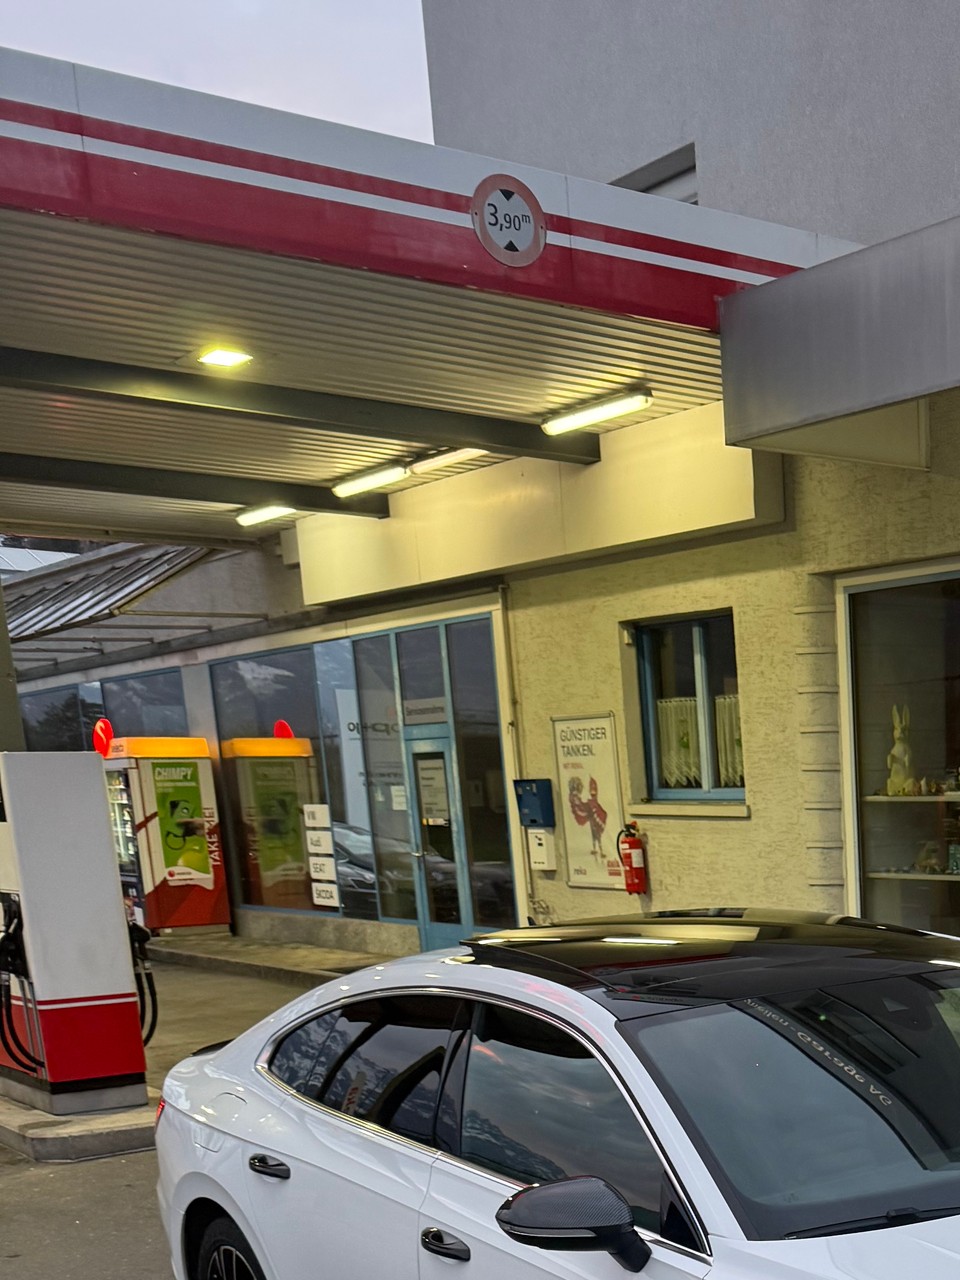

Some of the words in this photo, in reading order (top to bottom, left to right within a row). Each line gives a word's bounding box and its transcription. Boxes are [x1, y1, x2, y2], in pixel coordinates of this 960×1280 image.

[560, 727, 607, 742] GÜNSTIGER
[155, 767, 193, 780] CHIMPY
[313, 863, 325, 873] SEAT
